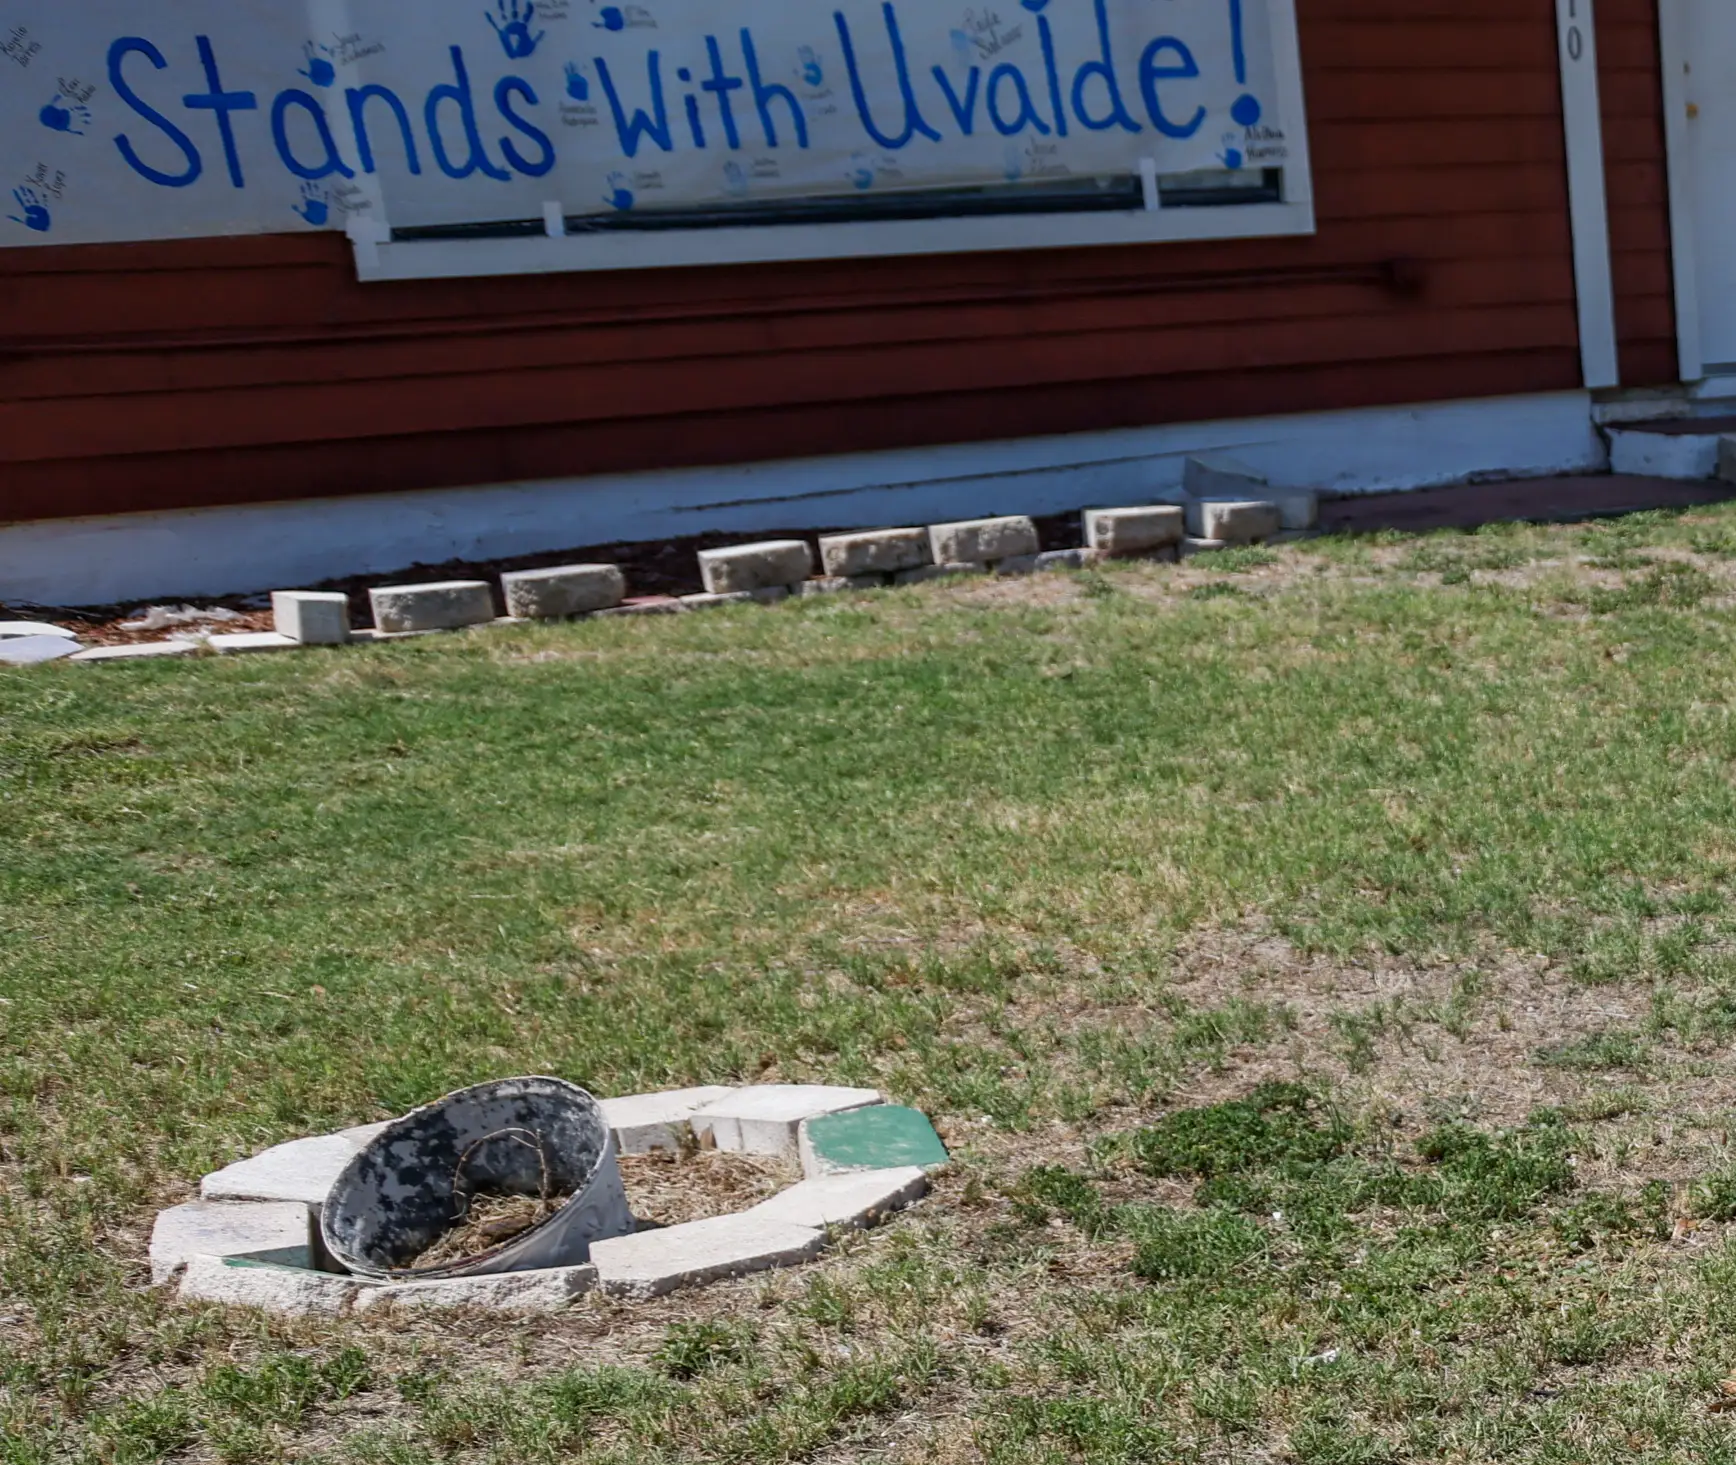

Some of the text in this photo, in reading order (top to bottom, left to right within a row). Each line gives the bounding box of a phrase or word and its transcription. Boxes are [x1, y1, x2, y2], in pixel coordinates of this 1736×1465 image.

[108, 0, 1261, 188] Stands With Uvalde!
